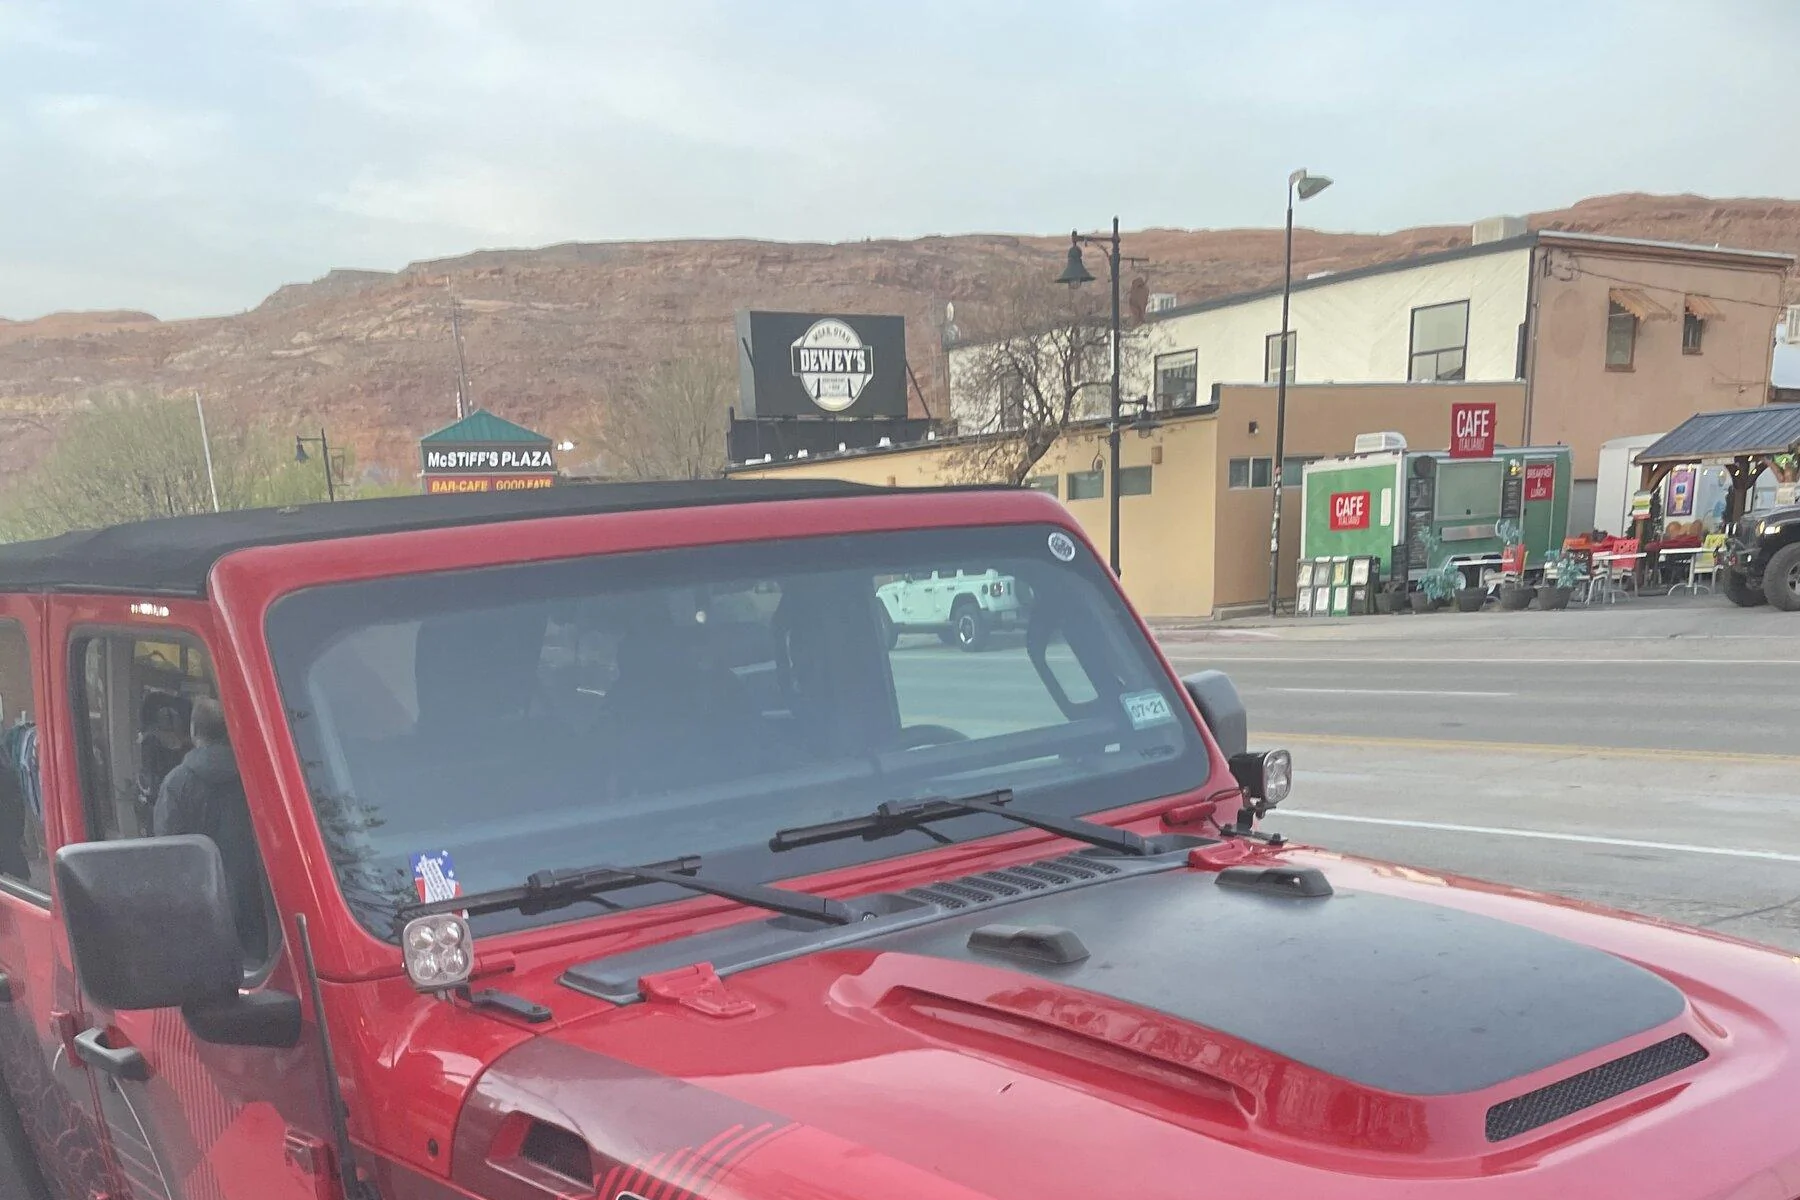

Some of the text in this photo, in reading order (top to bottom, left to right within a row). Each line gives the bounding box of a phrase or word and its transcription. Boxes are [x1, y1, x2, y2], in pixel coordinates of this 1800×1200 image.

[800, 349, 866, 373] DEWEY'S
[1456, 409, 1490, 438] CAFE
[428, 451, 552, 468] McSTIFF'S PLAZA
[1335, 495, 1365, 518] CAFE
